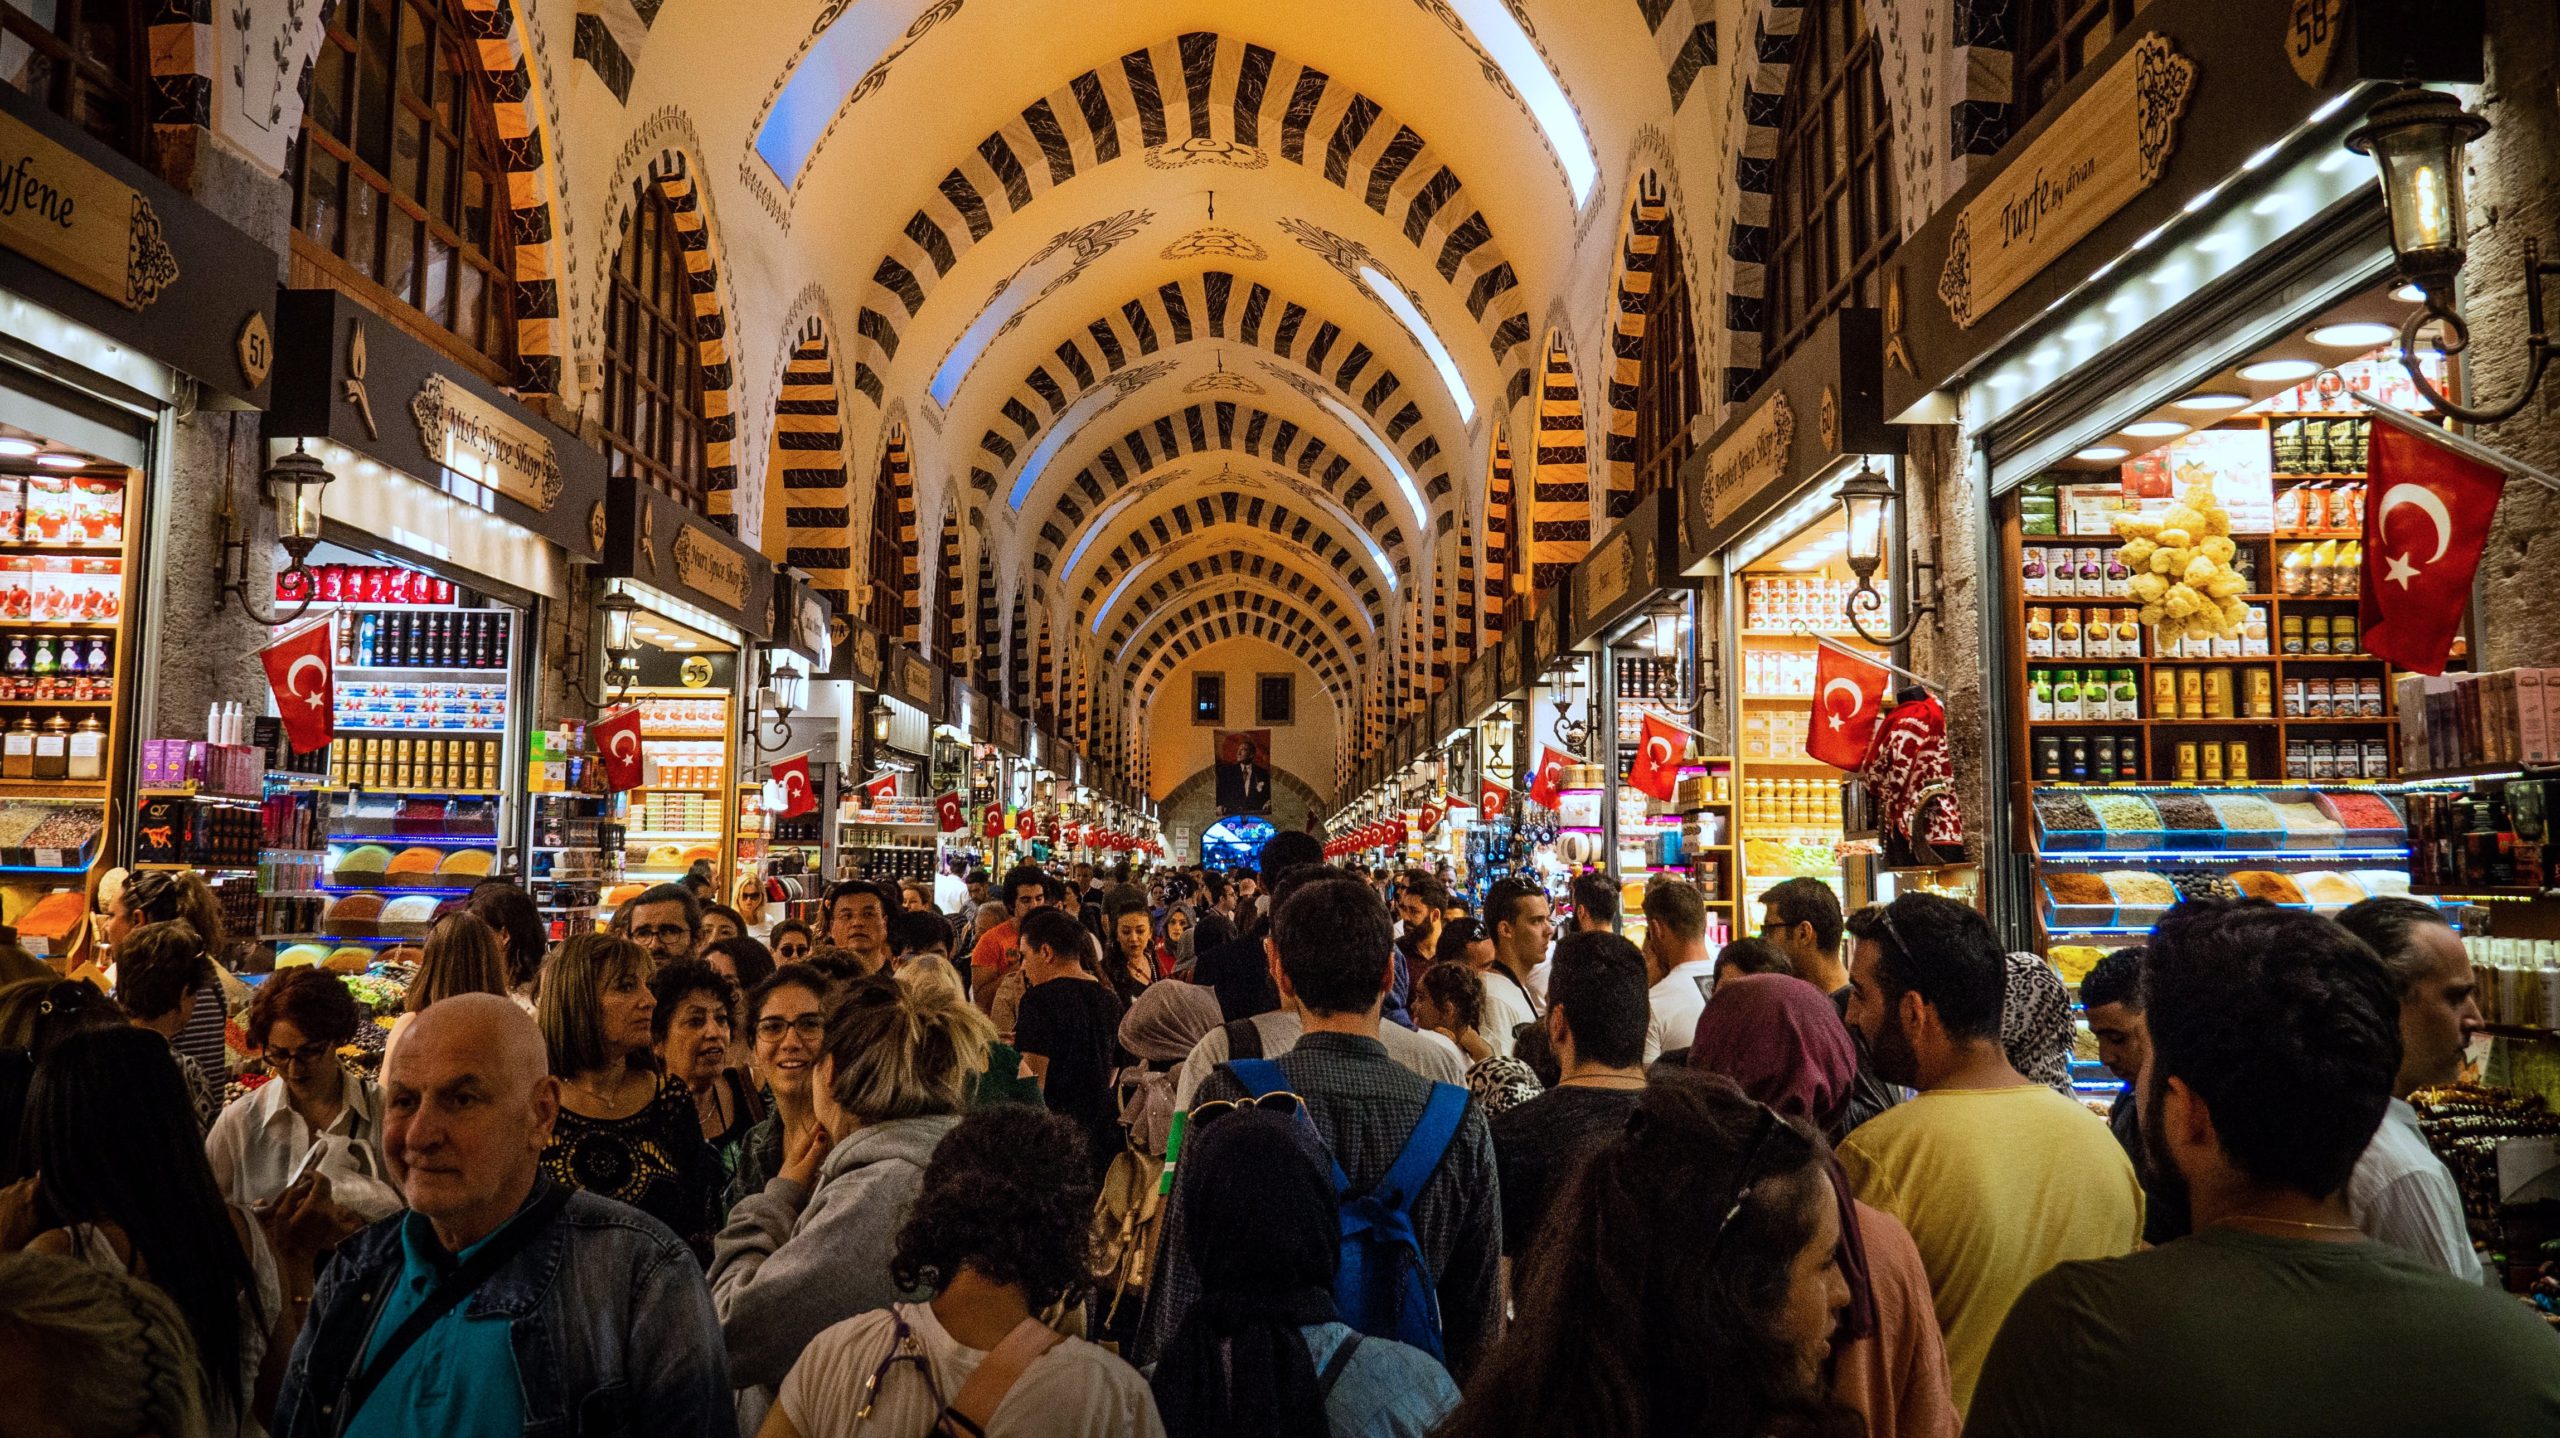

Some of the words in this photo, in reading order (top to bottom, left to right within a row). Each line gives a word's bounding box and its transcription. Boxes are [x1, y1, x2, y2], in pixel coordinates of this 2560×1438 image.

[2296, 0, 2327, 57] 58
[2000, 167, 2049, 249] Turfe
[2052, 181, 2064, 210] by
[249, 333, 265, 369] 51
[446, 407, 479, 447] Misk
[481, 425, 512, 465] Spice
[514, 443, 541, 488] Shop
[687, 664, 708, 682] 55
[149, 804, 171, 817] Q7
